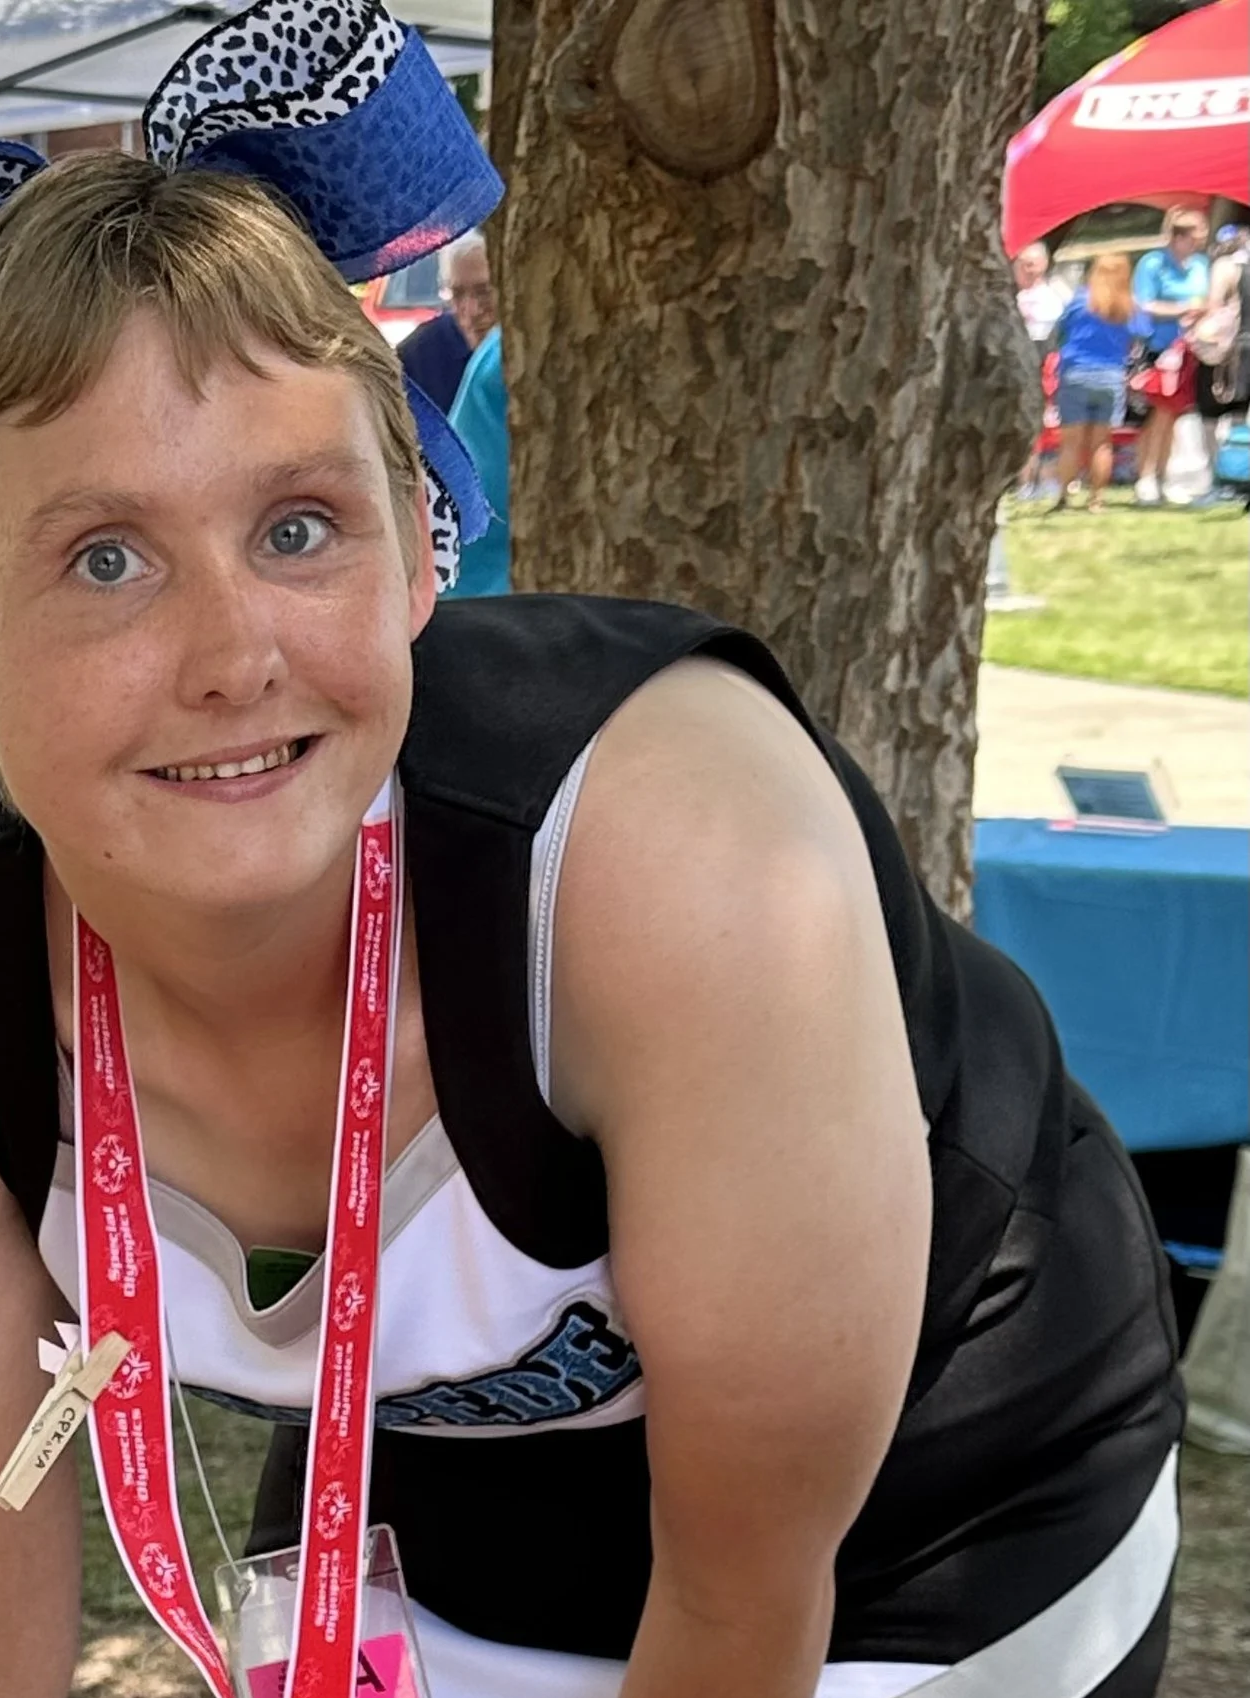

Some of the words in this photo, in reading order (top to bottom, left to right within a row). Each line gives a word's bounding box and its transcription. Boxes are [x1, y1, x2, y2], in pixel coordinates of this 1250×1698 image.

[102, 1206, 121, 1283] Special
[117, 1203, 137, 1297] Olympics
[114, 1411, 135, 1486] Special
[131, 1408, 149, 1501] Olympics
[313, 1551, 329, 1627] Special
[324, 1549, 341, 1643] Olympics
